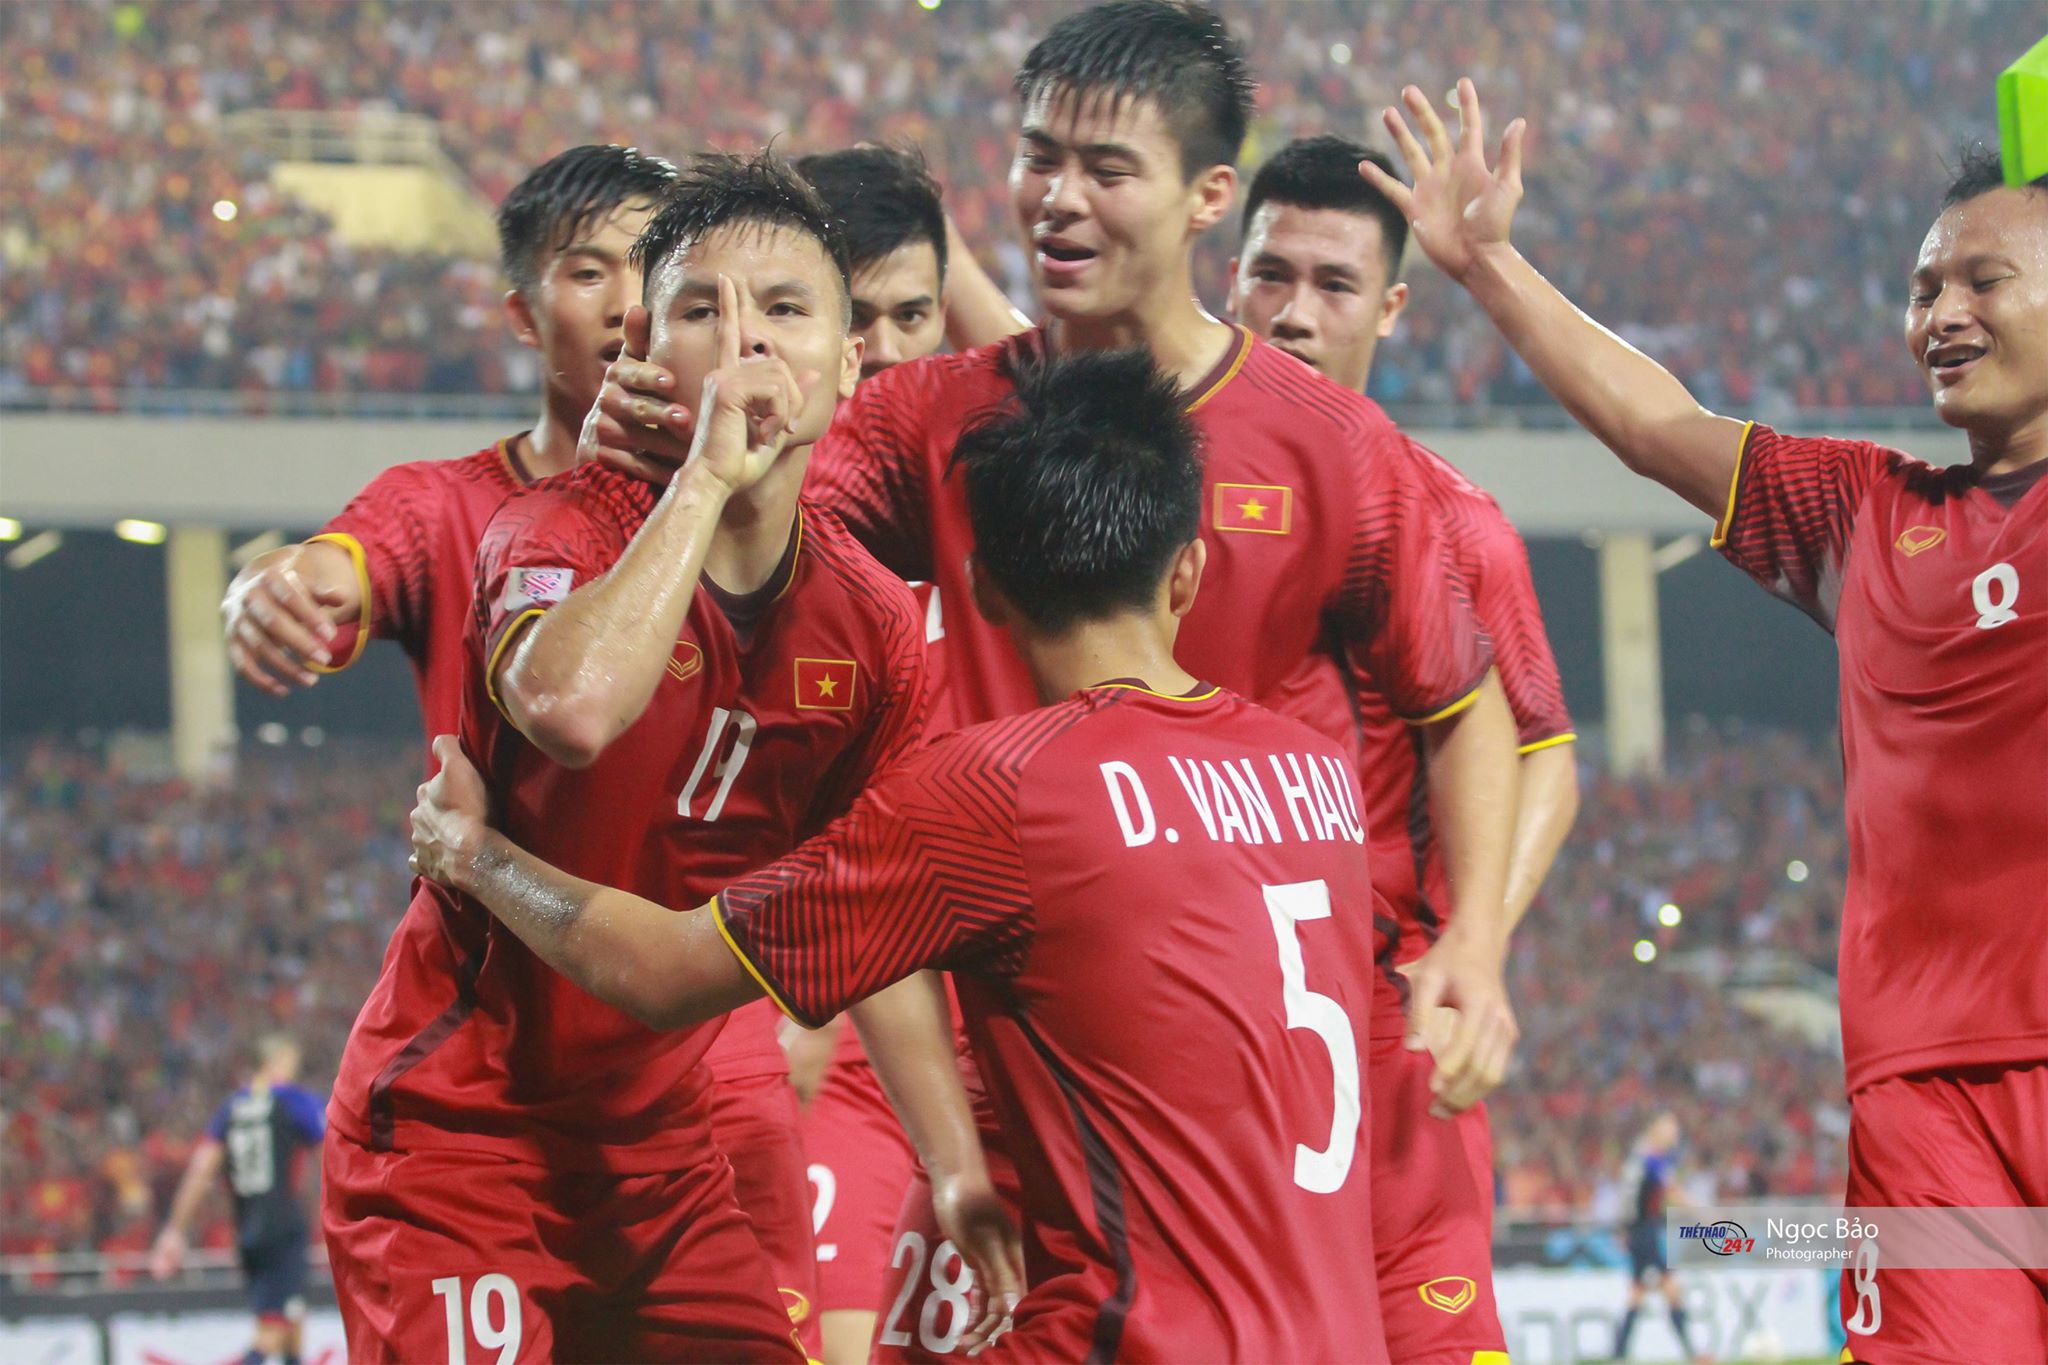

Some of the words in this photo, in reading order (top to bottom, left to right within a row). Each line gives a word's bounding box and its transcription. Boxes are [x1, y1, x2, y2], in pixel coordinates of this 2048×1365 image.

[1972, 562, 2018, 629] 8
[677, 706, 757, 822] 19
[1099, 760, 1180, 848] D.
[1167, 755, 1283, 844] VAN
[1268, 752, 1365, 844] HAU
[1262, 879, 1361, 1194] 5
[431, 1272, 523, 1365] 19
[879, 1231, 975, 1354] 28
[1847, 1239, 1882, 1336] 8
